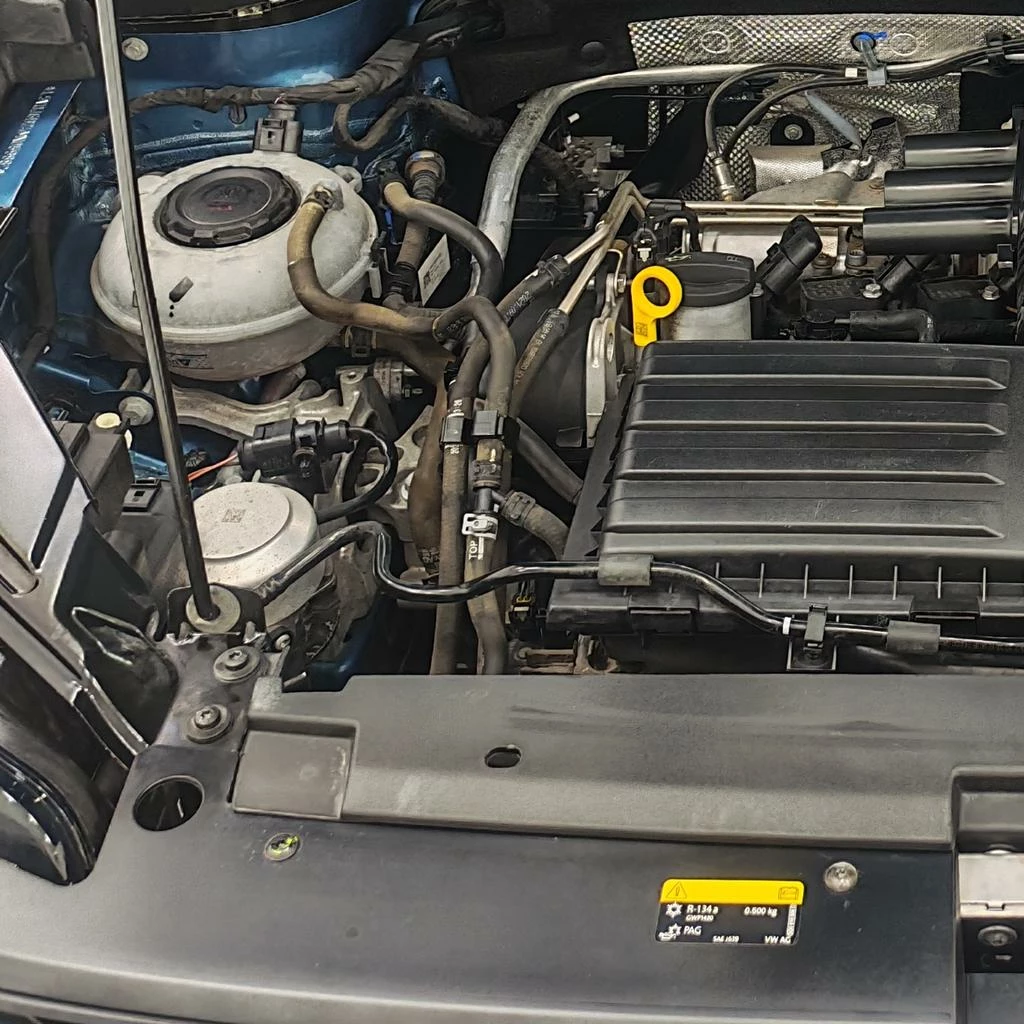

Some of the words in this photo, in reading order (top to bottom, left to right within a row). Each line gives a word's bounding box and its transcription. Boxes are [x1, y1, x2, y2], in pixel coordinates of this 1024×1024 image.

[468, 540, 480, 560] TOP
[767, 907, 778, 918] kg
[683, 925, 702, 936] PAG
[764, 936, 779, 944] VW
[780, 936, 791, 944] AG
